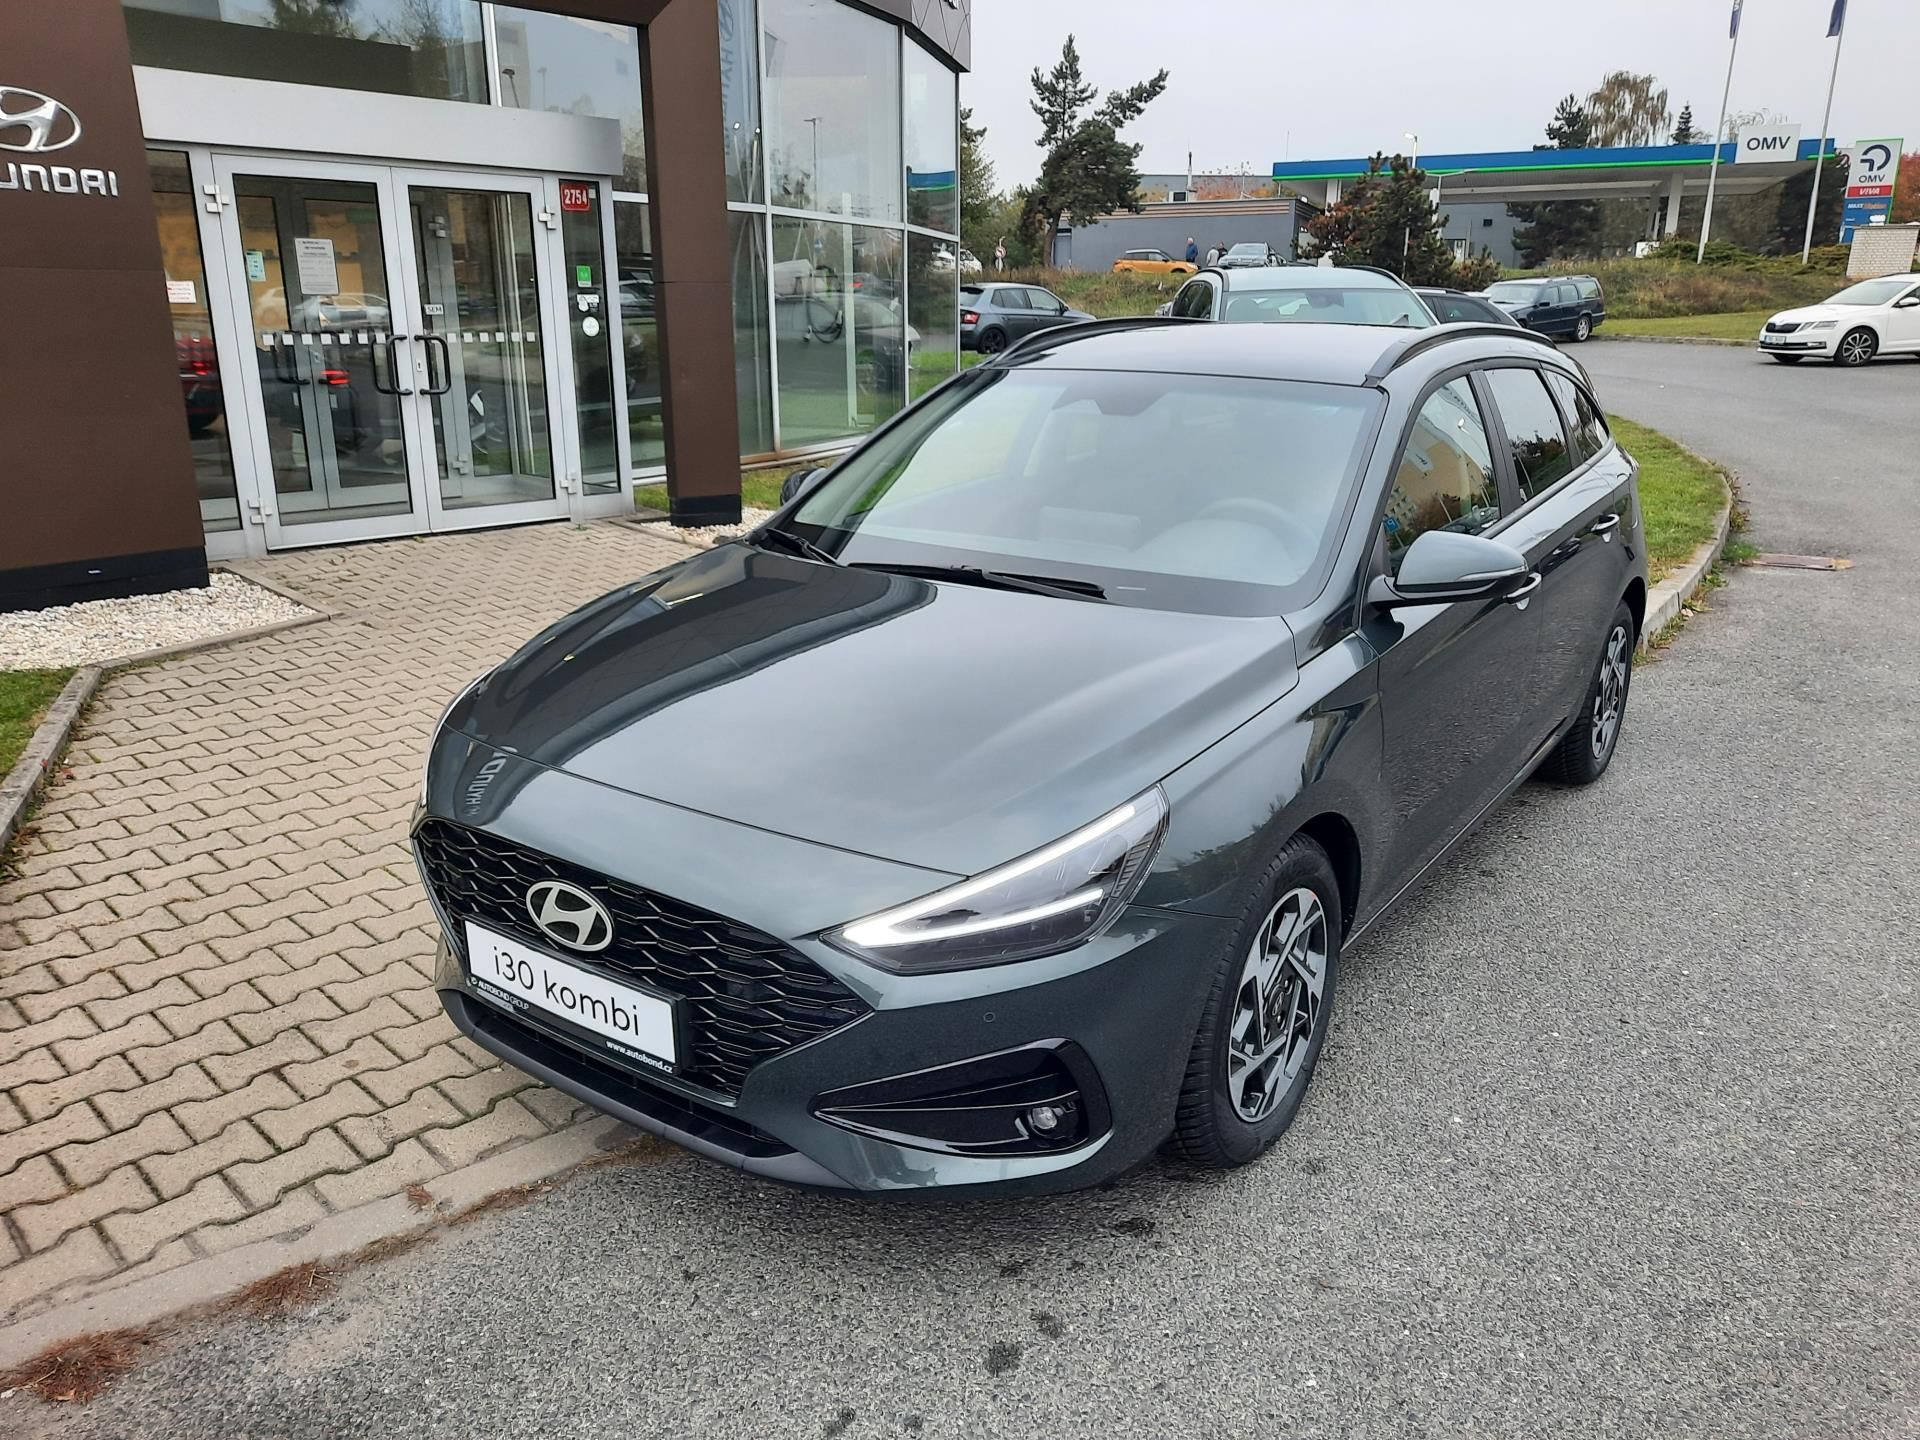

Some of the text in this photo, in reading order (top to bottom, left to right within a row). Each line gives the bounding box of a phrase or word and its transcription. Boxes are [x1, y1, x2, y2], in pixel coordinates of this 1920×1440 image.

[1746, 135, 1791, 151] OMV
[1858, 174, 1886, 184] OMV
[563, 188, 588, 206] 2754
[492, 945, 639, 1036] i30 kombi
[605, 1040, 673, 1074] www.autobond.cz
